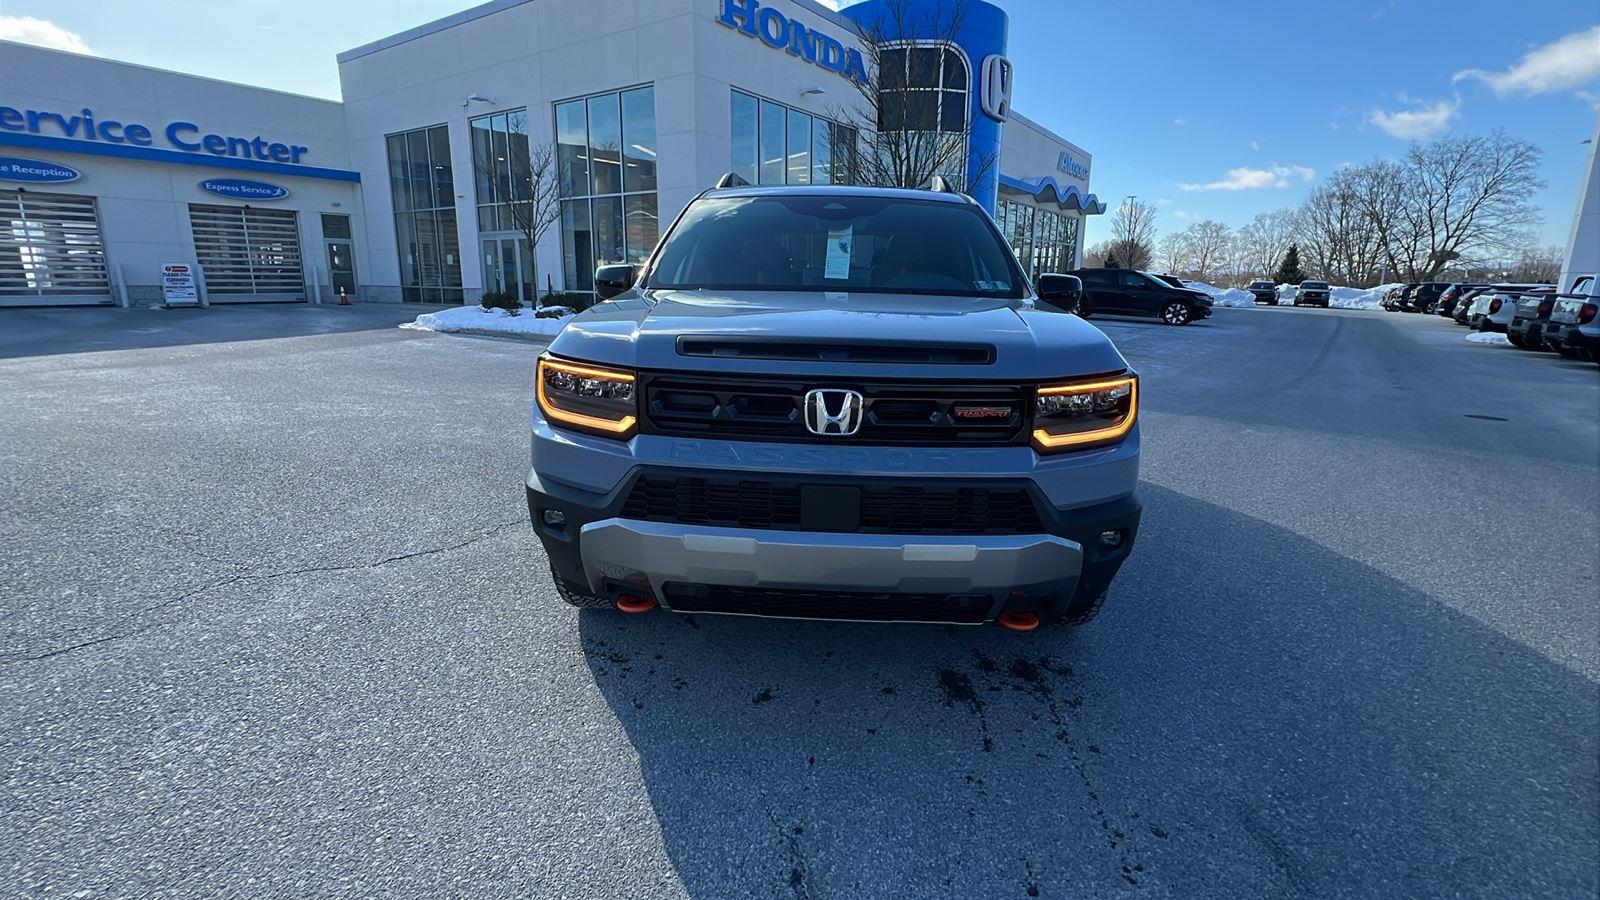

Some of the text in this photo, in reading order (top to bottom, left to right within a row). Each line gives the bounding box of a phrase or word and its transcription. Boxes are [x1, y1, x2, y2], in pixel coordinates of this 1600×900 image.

[715, 0, 870, 86] HONDA
[165, 121, 308, 164] Center
[11, 164, 73, 177] Reception
[205, 182, 272, 195] Express Service
[670, 439, 1002, 471] PASSPORT
